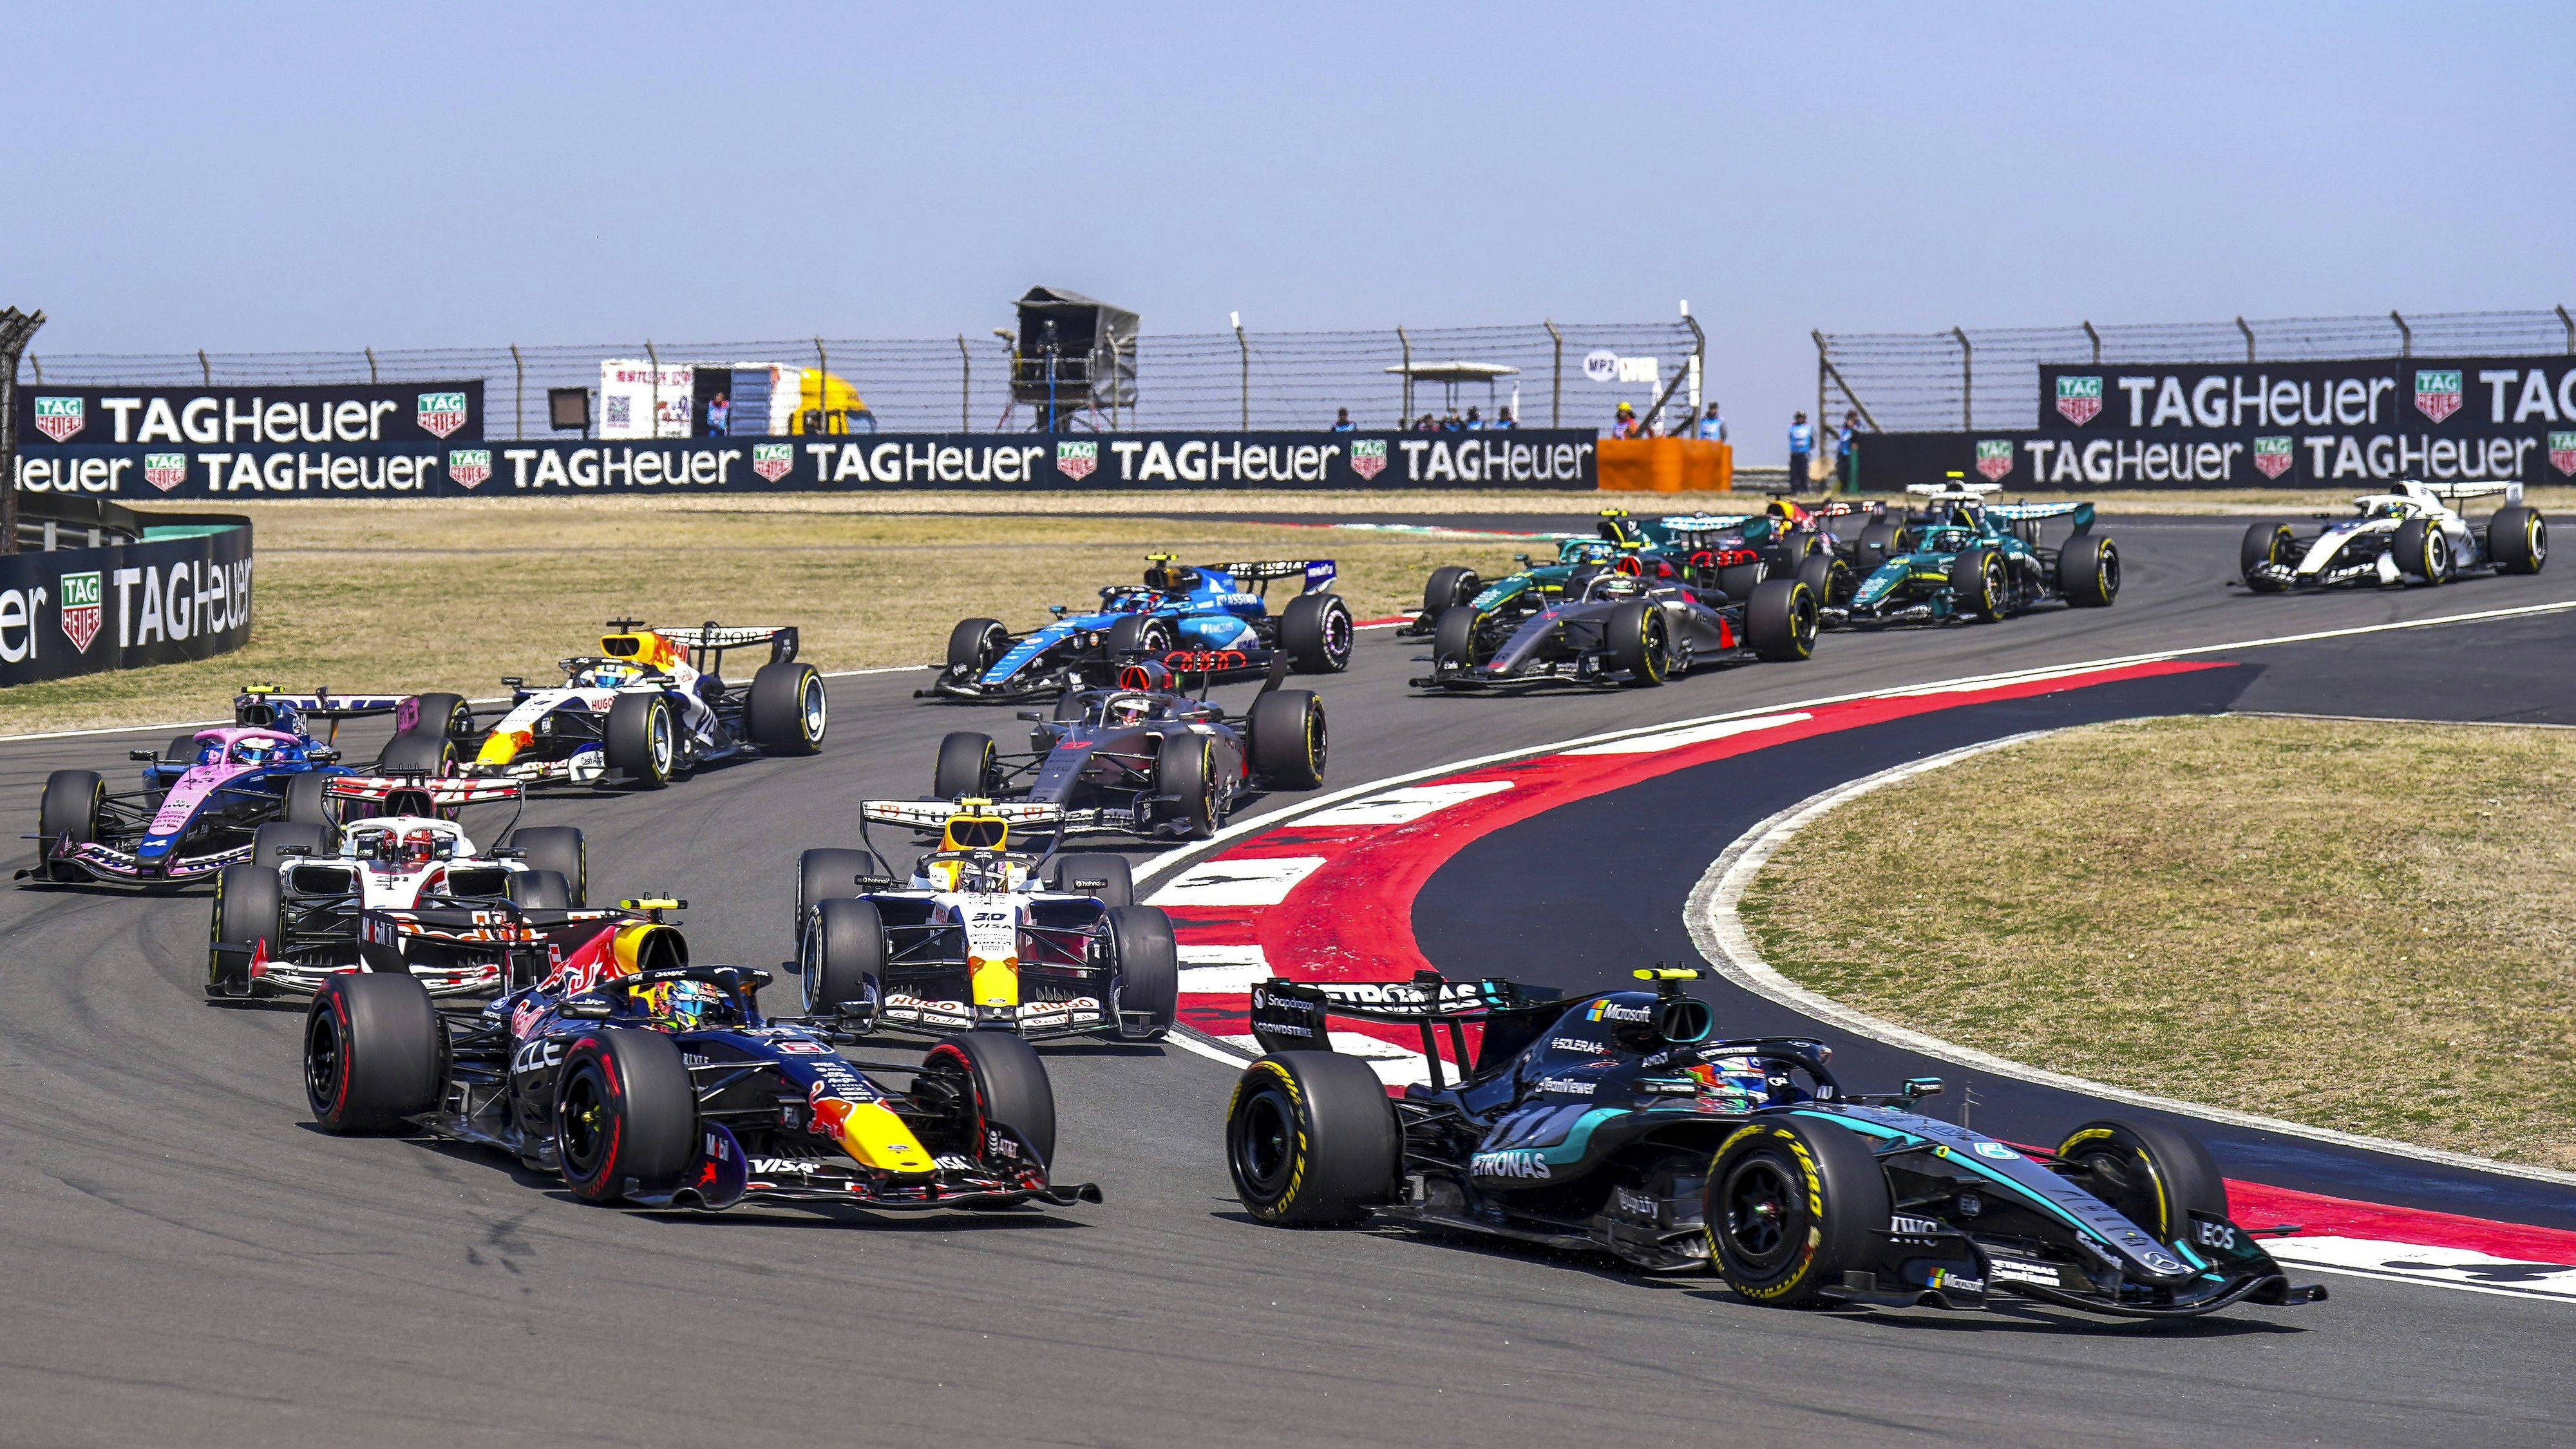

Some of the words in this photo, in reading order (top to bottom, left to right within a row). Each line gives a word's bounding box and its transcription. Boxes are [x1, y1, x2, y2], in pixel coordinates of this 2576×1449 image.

[2060, 379, 2099, 396] TAG
[2420, 374, 2459, 391] TAG
[39, 399, 79, 415] TAG
[422, 395, 463, 412] TAG
[2118, 374, 2396, 428] TAGHeuer
[100, 396, 398, 444] TAGHeuer
[147, 455, 184, 468] TAG
[806, 442, 1045, 482] TAGHeuer
[1111, 440, 1341, 481] TAGHeuer
[1399, 439, 1594, 481] TAGHeuer
[2024, 439, 2244, 482] TAGHeuer
[2304, 434, 2536, 478] TAGHeuer
[197, 451, 438, 491] TAGHeuer
[504, 446, 743, 488] TAGHeuer
[64, 576, 98, 603] TAG
[113, 558, 252, 647] TAGHeuer
[64, 610, 100, 646] HEUER
[908, 807, 1015, 824] TUR
[972, 913, 1007, 922] 30
[361, 916, 386, 945] Mobil
[891, 997, 957, 1011] HUGO
[1032, 998, 1095, 1013] HUGO
[1267, 994, 1314, 1013] Snapdragon
[1297, 983, 1482, 1015] ETRONAS
[1603, 1003, 1652, 1023] Microsoft
[1257, 1022, 1313, 1038] CROWDSTRIKE
[1558, 1037, 1595, 1054] SOLERA
[515, 1040, 563, 1074] CLE
[683, 1053, 710, 1065] RLYLE
[1544, 1076, 1598, 1095] TeamViewer
[748, 1159, 813, 1174] VISA
[1889, 1215, 1939, 1247] IWC
[1942, 1273, 1985, 1293] Microsoft
